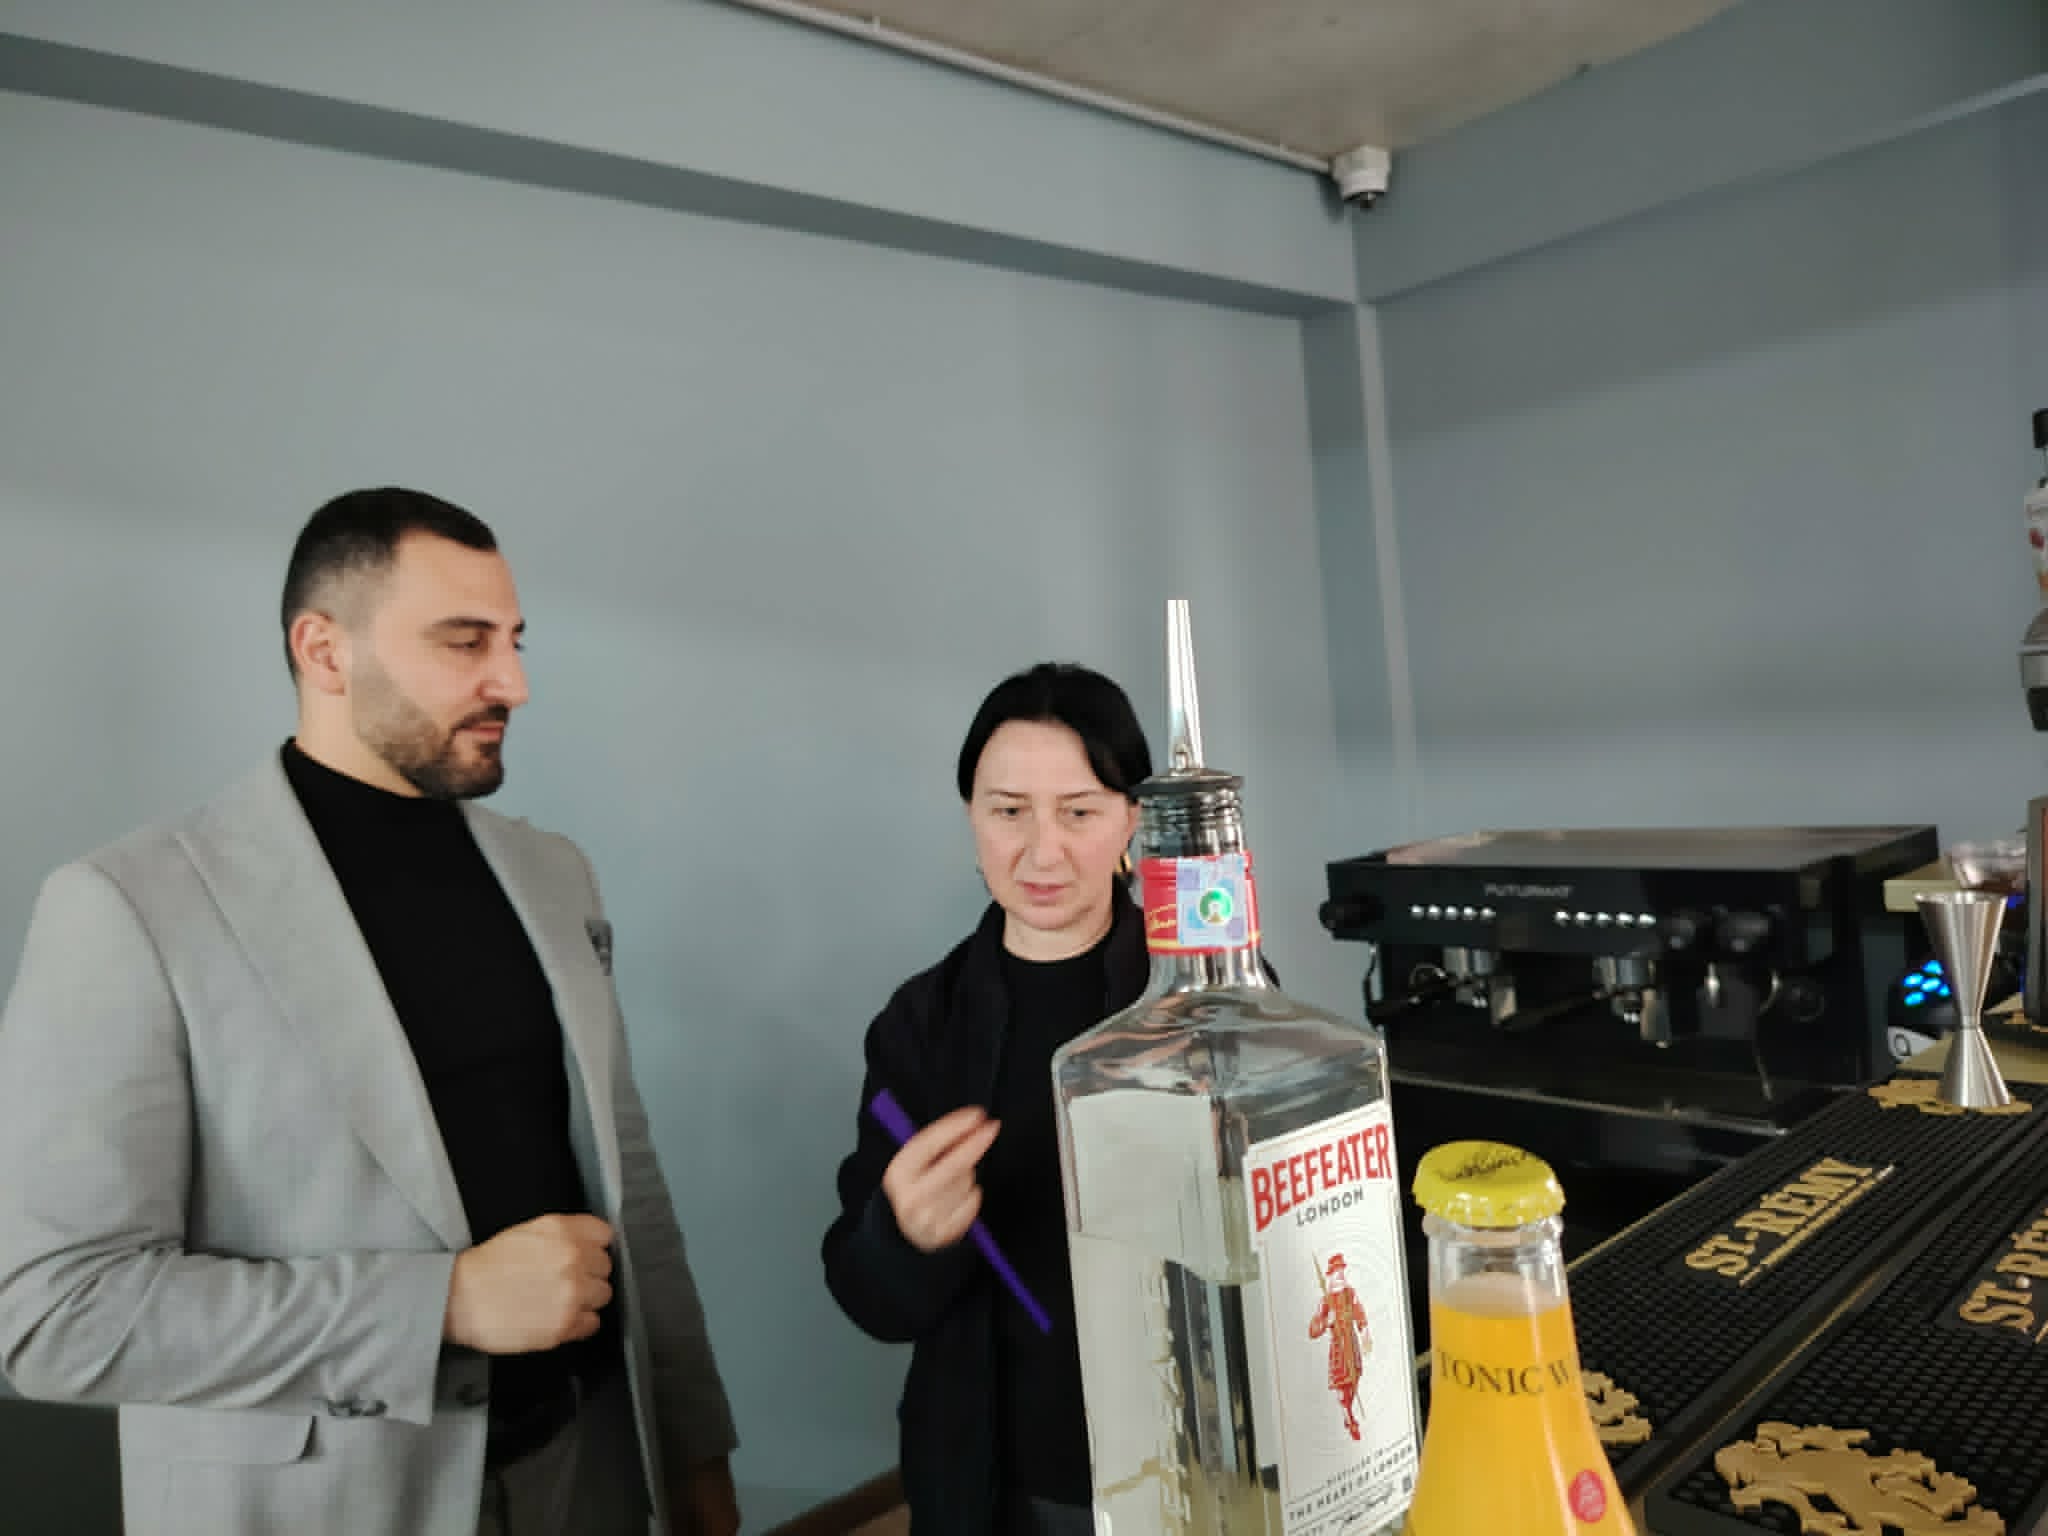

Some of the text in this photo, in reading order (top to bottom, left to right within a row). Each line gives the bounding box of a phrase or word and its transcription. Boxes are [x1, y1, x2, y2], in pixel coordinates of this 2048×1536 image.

[1251, 1123, 1393, 1233] BEEFEATER
[1296, 1187, 1364, 1227] LONDON
[1438, 1348, 1545, 1395] TONIC
